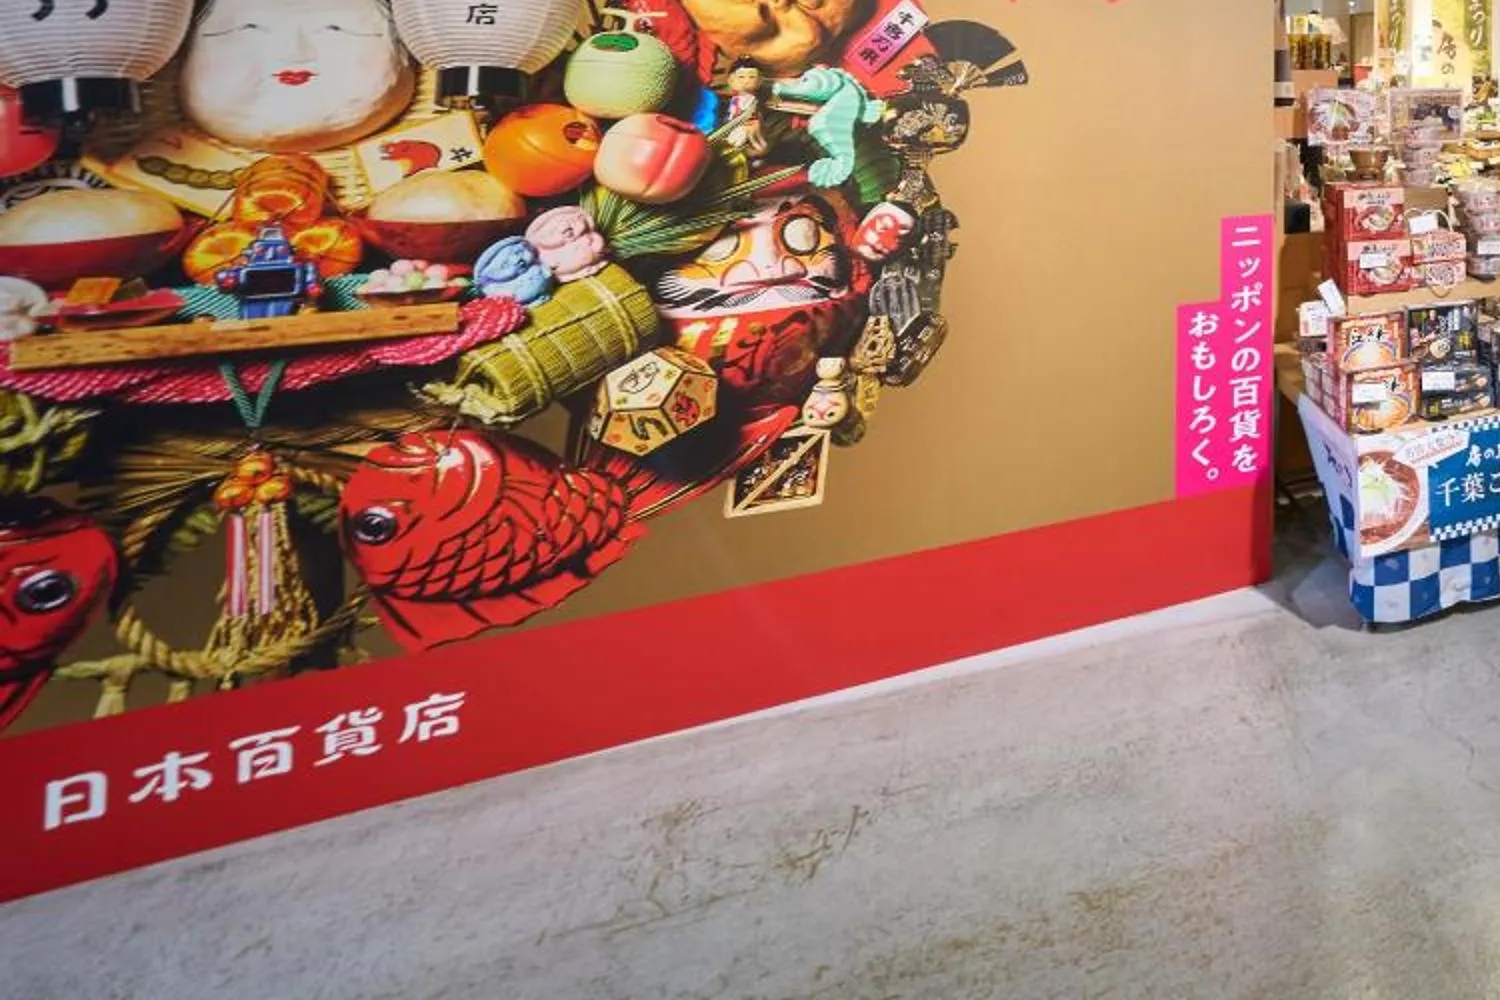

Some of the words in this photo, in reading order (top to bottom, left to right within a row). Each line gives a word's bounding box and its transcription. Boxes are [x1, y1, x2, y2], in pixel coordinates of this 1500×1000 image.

[1188, 311, 1220, 480] おもしろく。
[1229, 225, 1264, 473] ニッポンの百貨を
[43, 691, 467, 831] 日本百貨店
